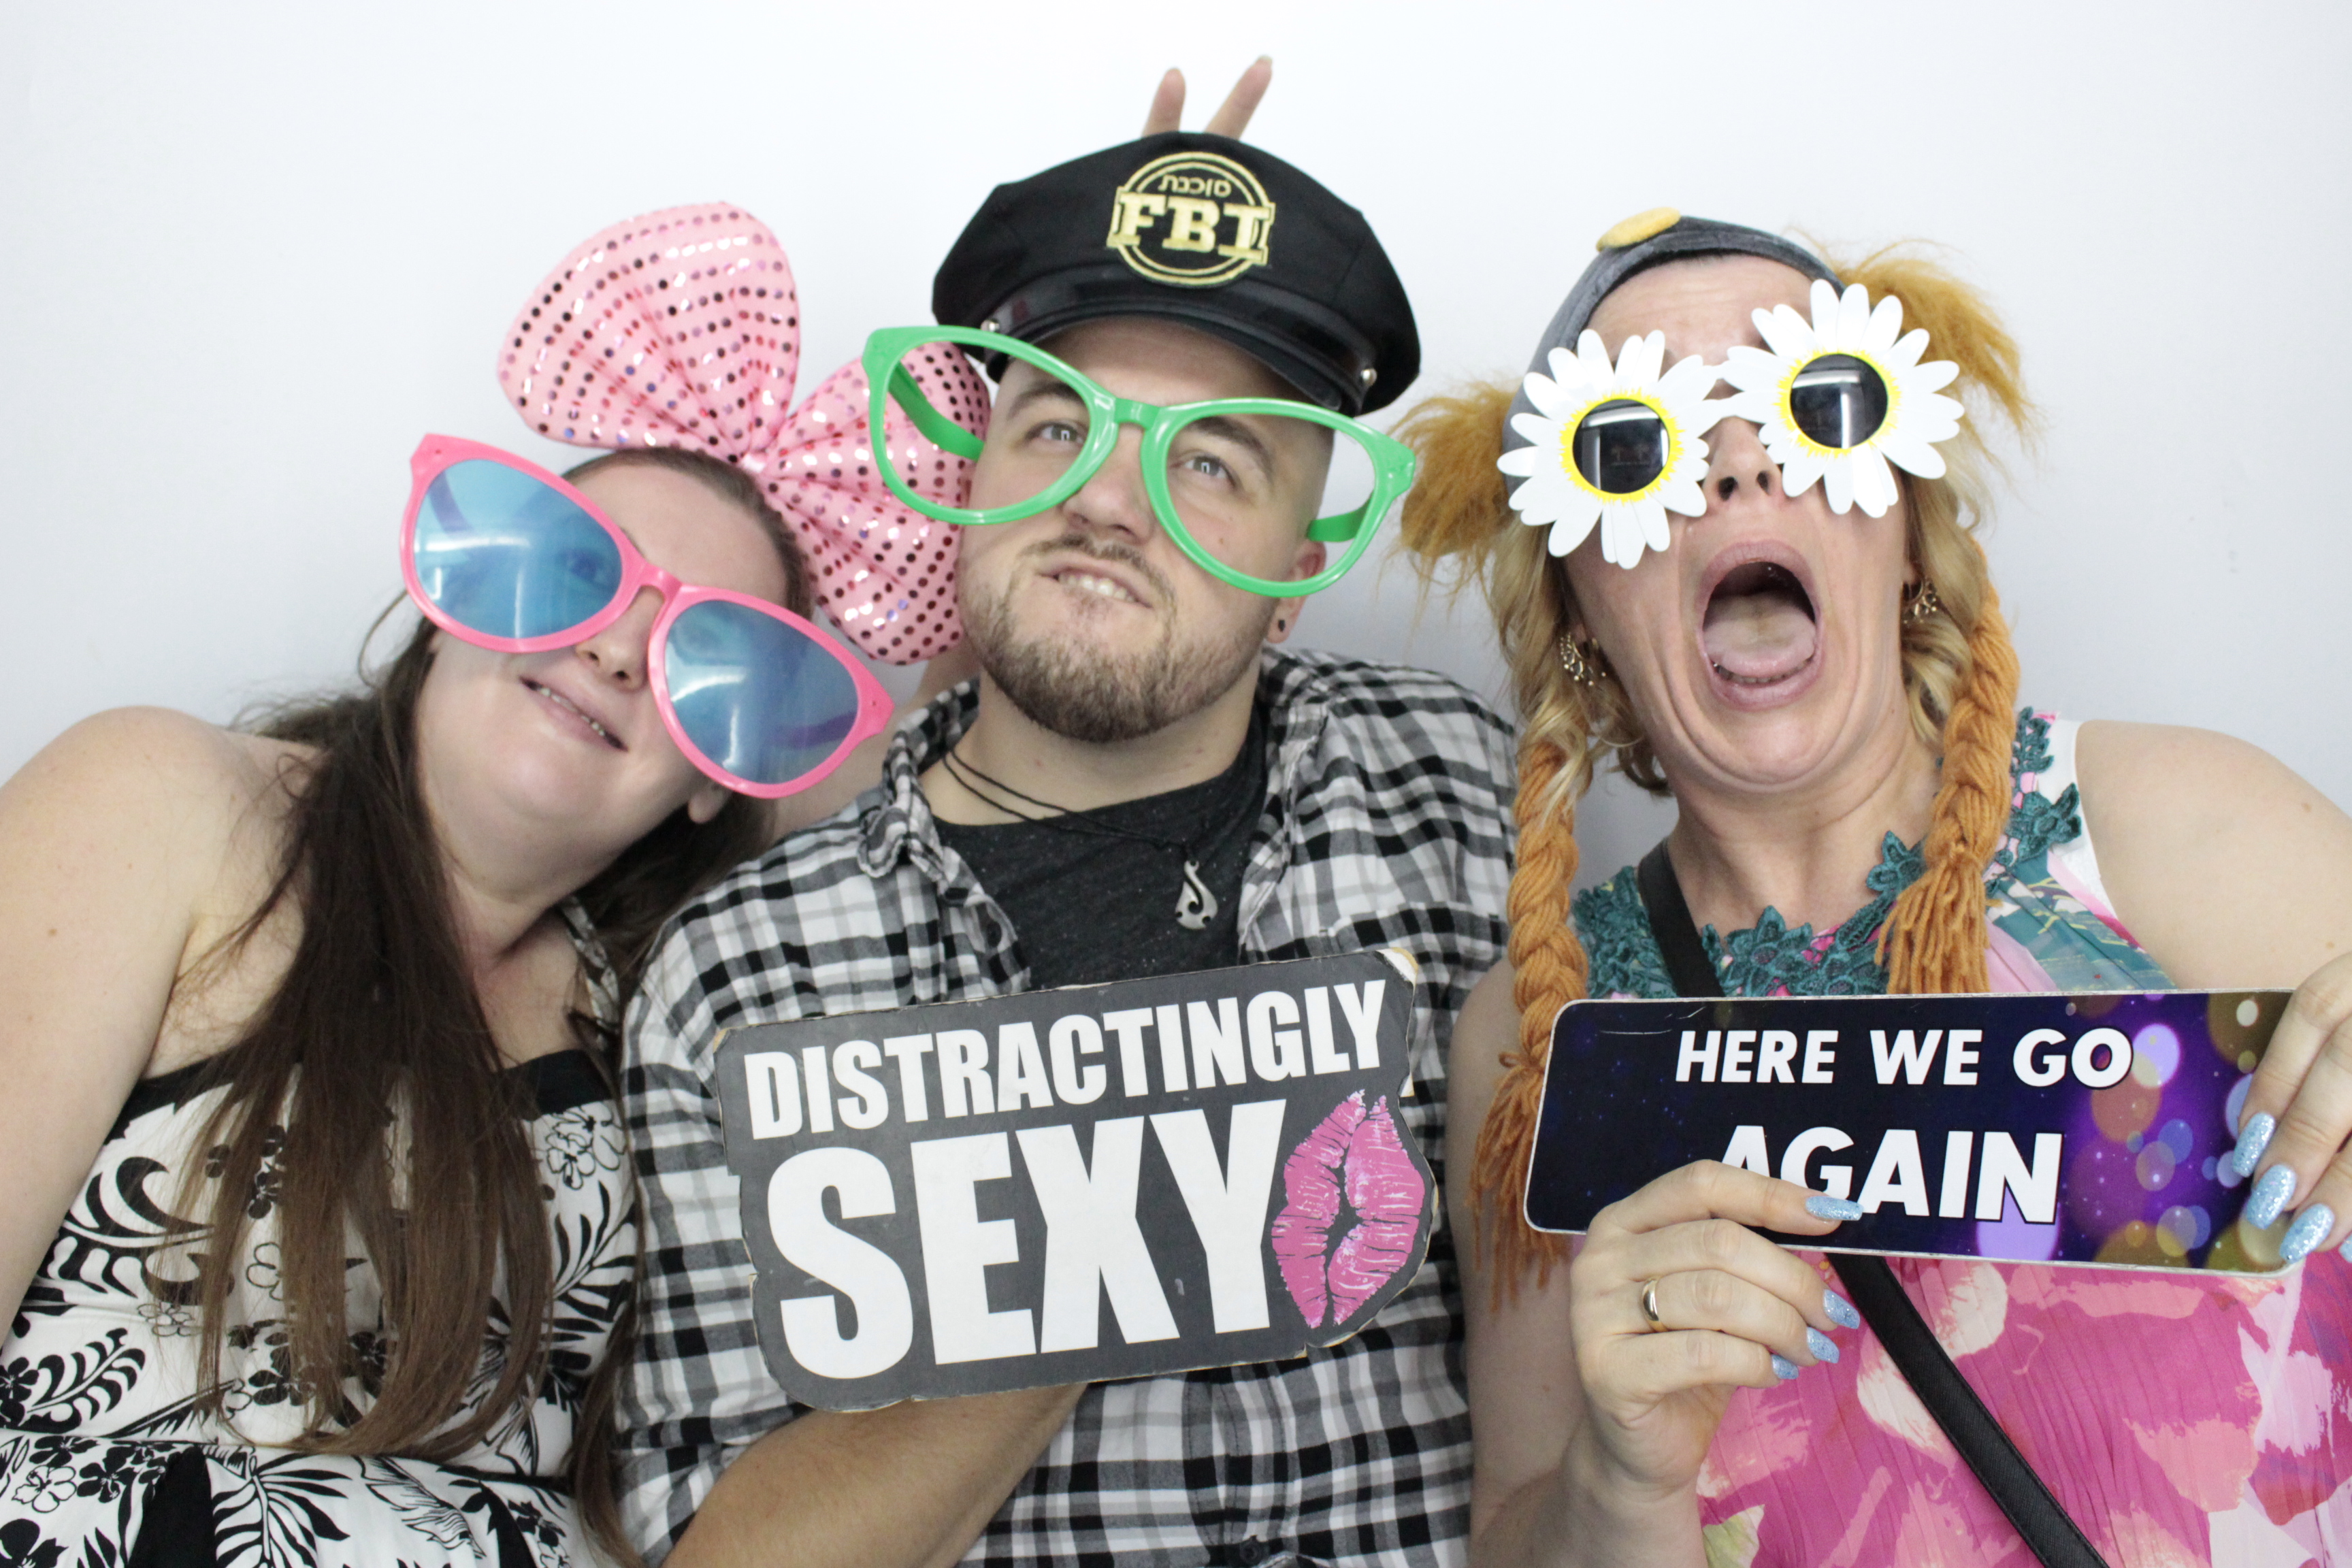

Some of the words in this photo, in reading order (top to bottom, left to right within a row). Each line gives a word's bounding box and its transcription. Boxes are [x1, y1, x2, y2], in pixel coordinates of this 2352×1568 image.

[1107, 189, 1274, 264] FBI
[744, 979, 1386, 1139] DISTRACTINGLY
[1676, 1030, 1839, 1083] HERE
[1870, 1030, 1982, 1085] WE
[2012, 1028, 2132, 1088] GO
[768, 1099, 1286, 1378] SEXY
